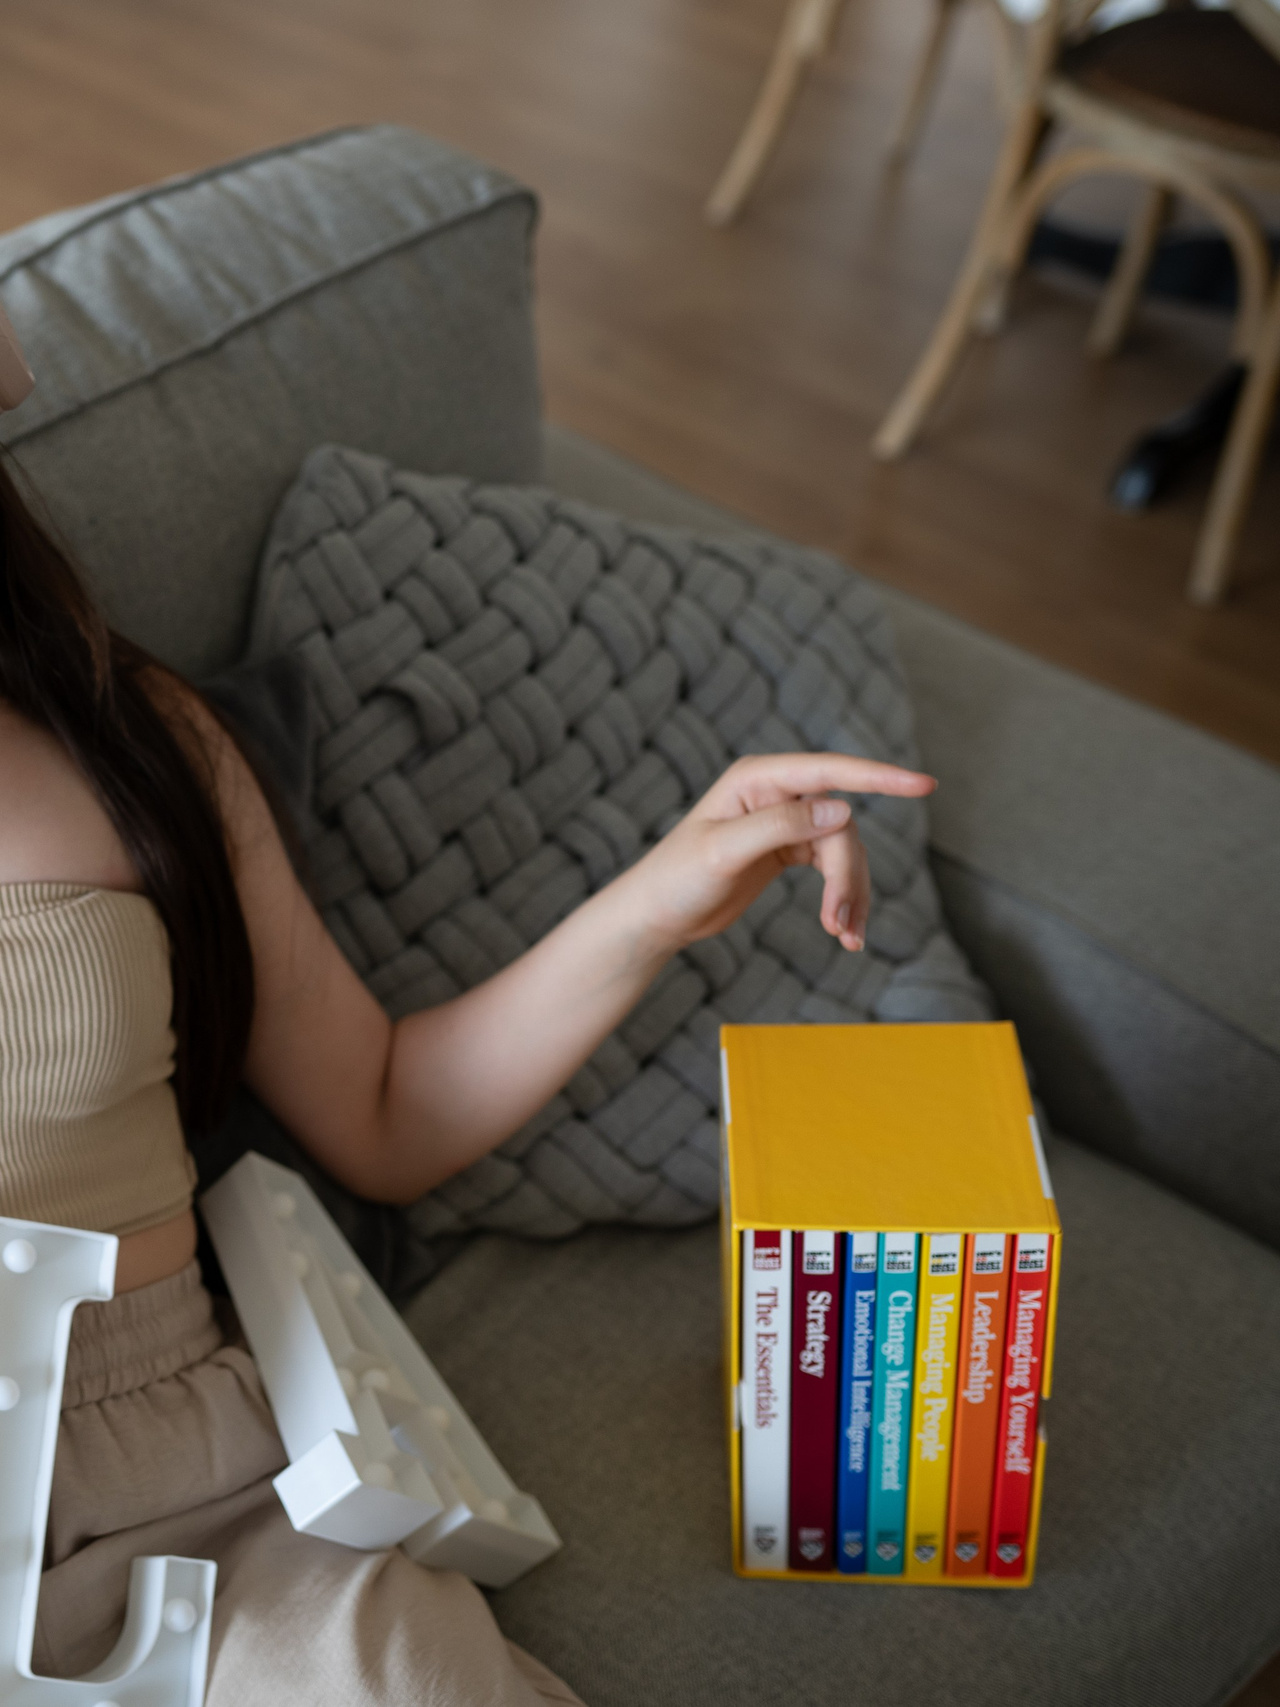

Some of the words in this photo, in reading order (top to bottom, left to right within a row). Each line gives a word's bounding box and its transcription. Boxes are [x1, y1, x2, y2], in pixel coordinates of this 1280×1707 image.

[755, 1285, 779, 1327] The
[800, 1290, 833, 1378] Strategy
[852, 1290, 876, 1377] Emotional
[881, 1289, 913, 1366] Change
[919, 1293, 955, 1395] Managing
[962, 1290, 999, 1404] Leadership
[1007, 1289, 1043, 1389] Managing
[754, 1332, 778, 1429] Essentials
[846, 1380, 872, 1473] Intelligence
[877, 1370, 909, 1491] Management
[917, 1397, 948, 1462] People
[1004, 1390, 1035, 1474] Yourself
